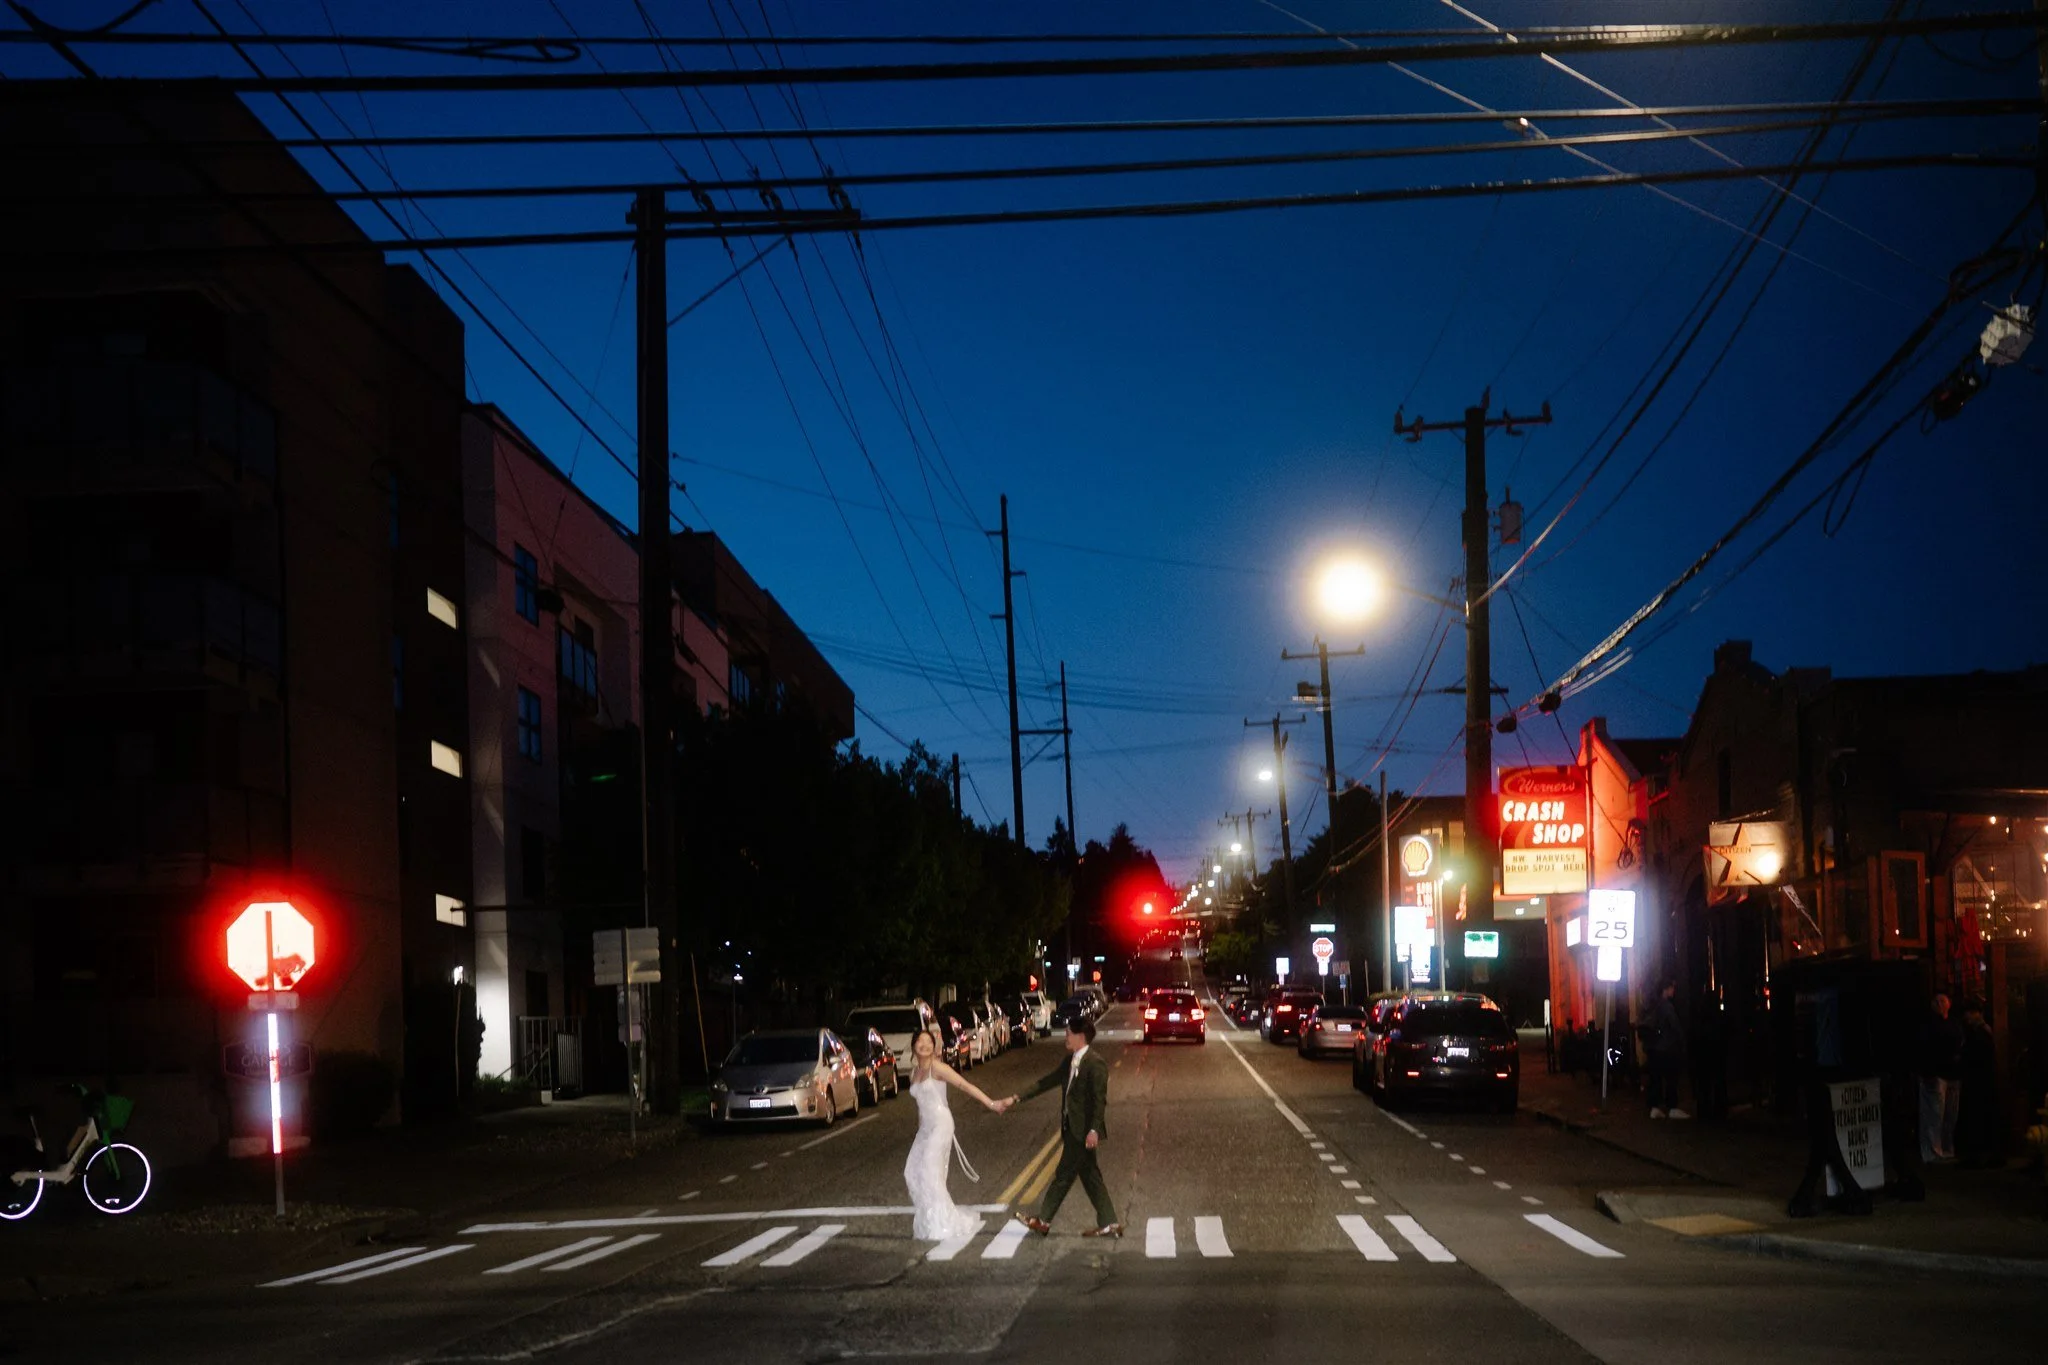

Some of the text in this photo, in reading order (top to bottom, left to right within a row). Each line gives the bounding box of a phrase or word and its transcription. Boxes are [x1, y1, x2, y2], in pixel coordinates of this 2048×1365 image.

[1503, 800, 1565, 822] CRASH
[1532, 823, 1585, 844] SHOP
[1512, 853, 1576, 863] NW HARVEST
[1505, 863, 1586, 873] DROP SPOT HERE
[1594, 920, 1628, 940] 25
[1314, 943, 1332, 953] STOP
[241, 1055, 295, 1067] GARGE
[1847, 1128, 1868, 1147] BRUNCH
[1849, 1149, 1868, 1168] TACOS
